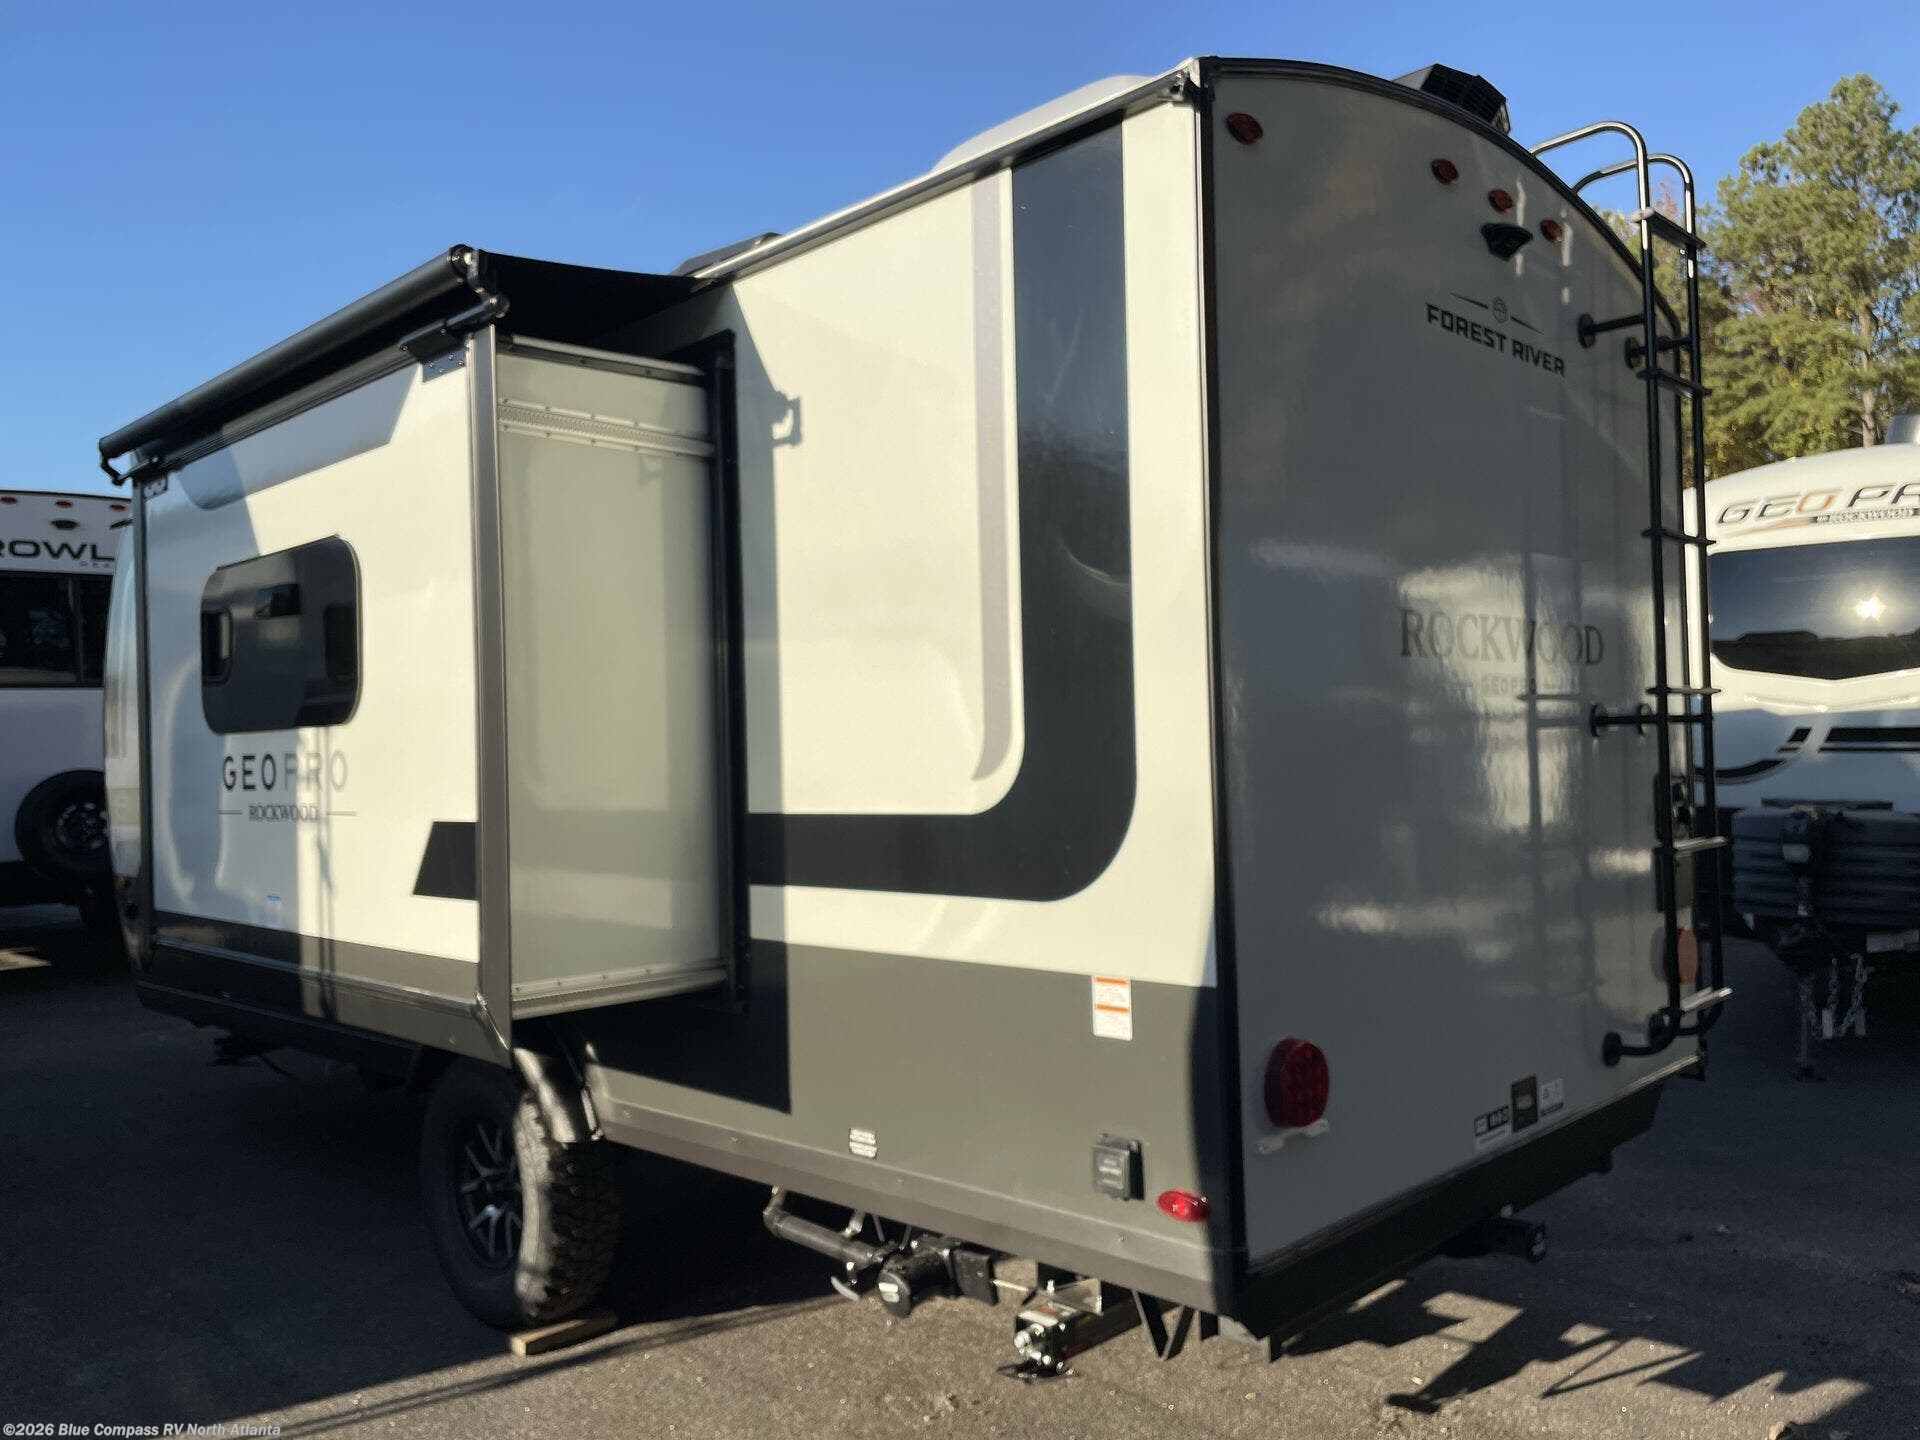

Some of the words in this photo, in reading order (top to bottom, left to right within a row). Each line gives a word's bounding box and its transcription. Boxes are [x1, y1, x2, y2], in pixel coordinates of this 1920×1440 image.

[1425, 302, 1507, 351] FOREST
[1511, 339, 1566, 377] RIVER
[0, 540, 115, 561] OWL
[1400, 608, 1604, 666] ROCKWOOD
[248, 804, 319, 822] ROCKWOOD
